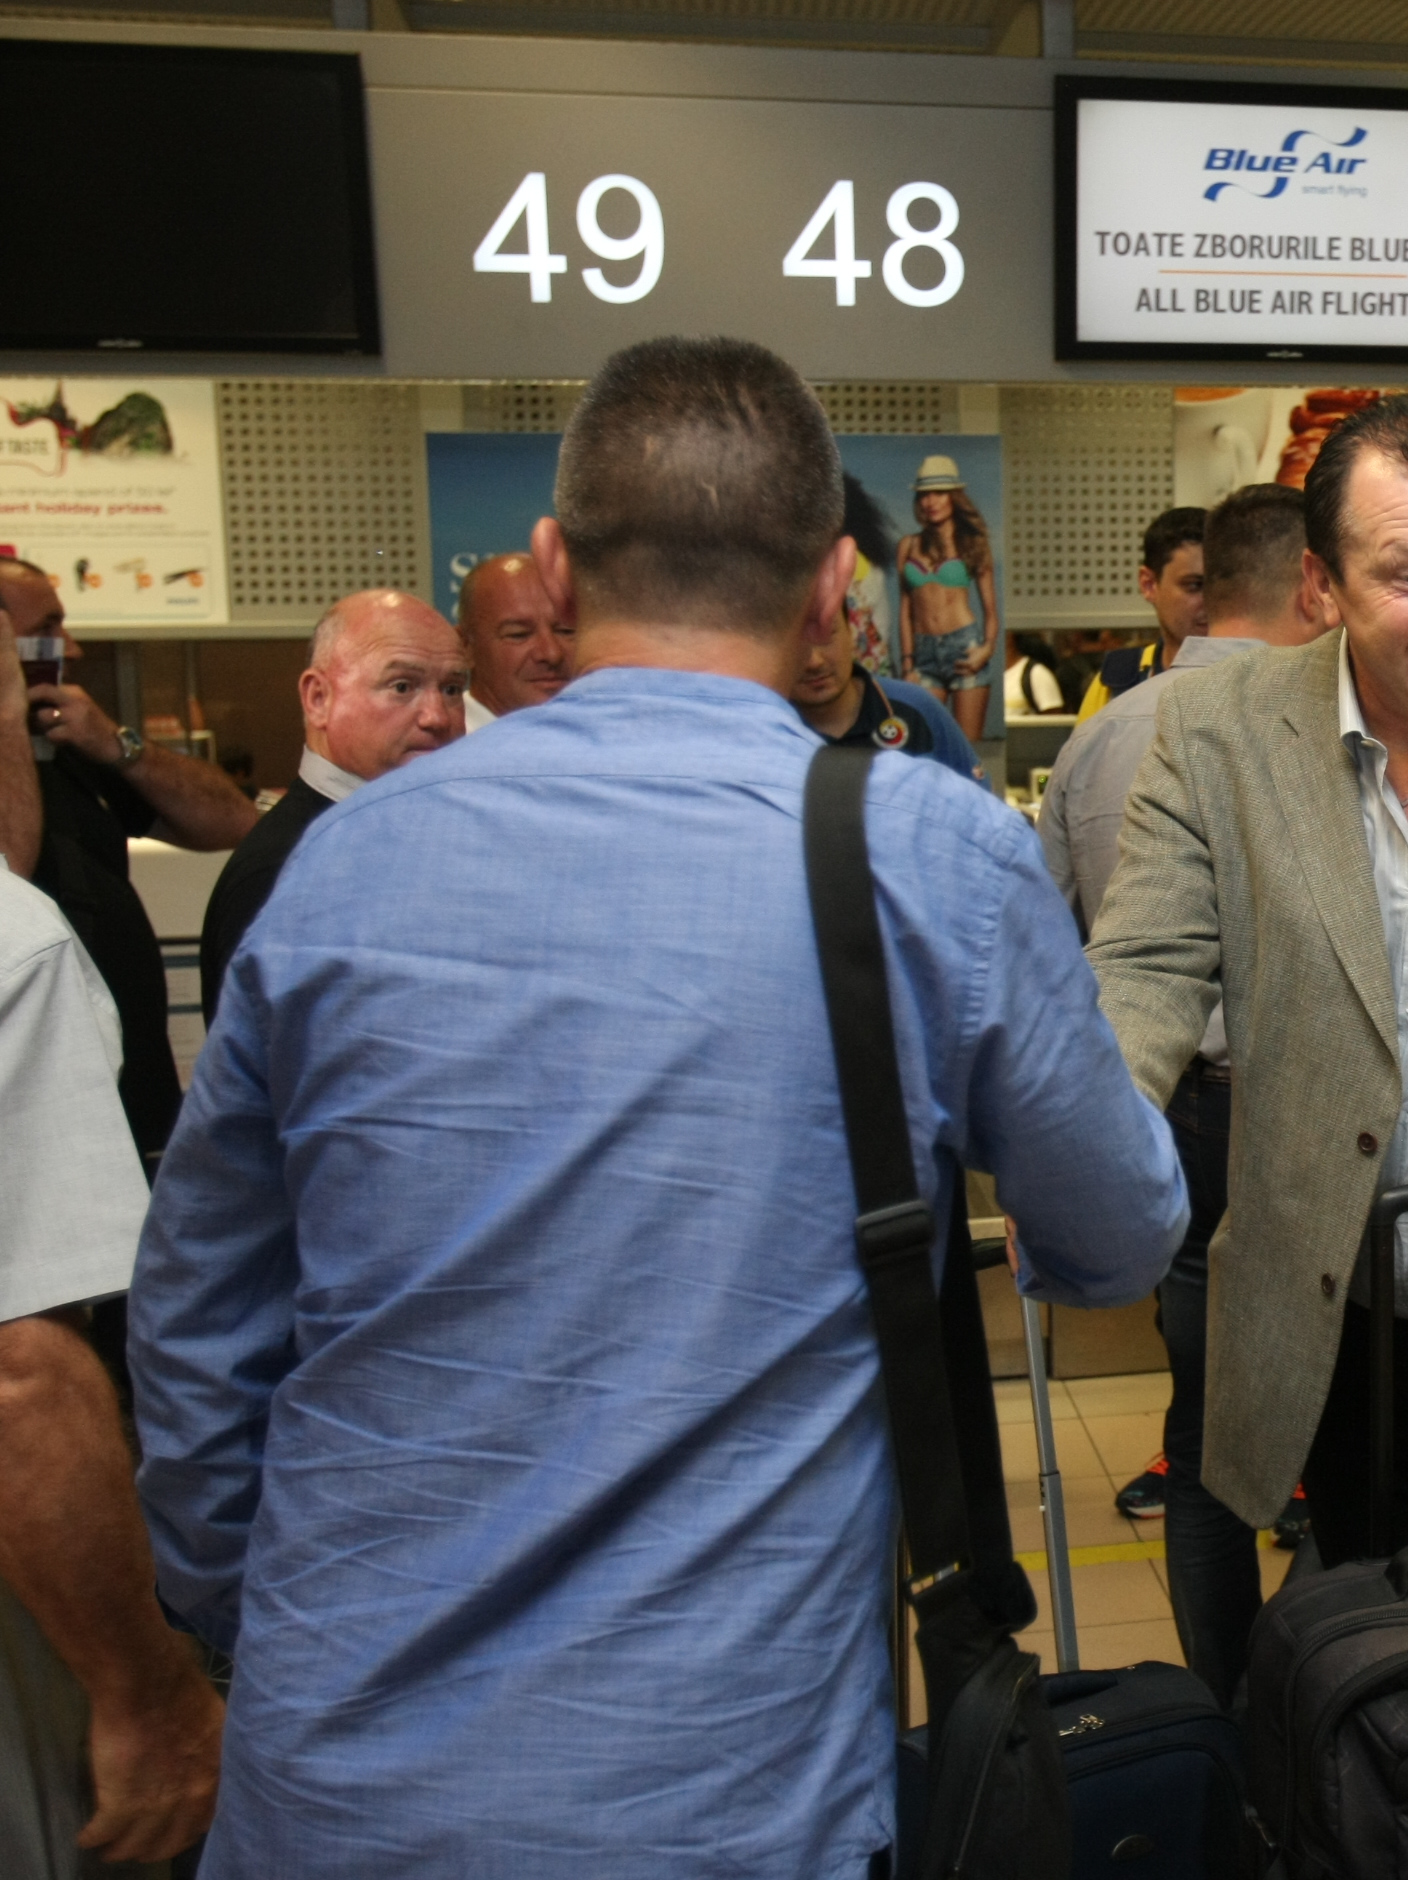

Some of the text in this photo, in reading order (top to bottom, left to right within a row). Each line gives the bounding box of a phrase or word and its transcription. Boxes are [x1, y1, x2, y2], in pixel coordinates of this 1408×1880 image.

[1203, 148, 1367, 174] Blue Air
[473, 172, 664, 304] 49
[783, 180, 964, 307] 48
[1095, 231, 1184, 258] TOATE
[1193, 234, 1342, 262] ZBORURILE
[1136, 288, 1185, 313] ALL
[1195, 289, 1262, 314] BLUE
[1271, 291, 1313, 315] AIR
